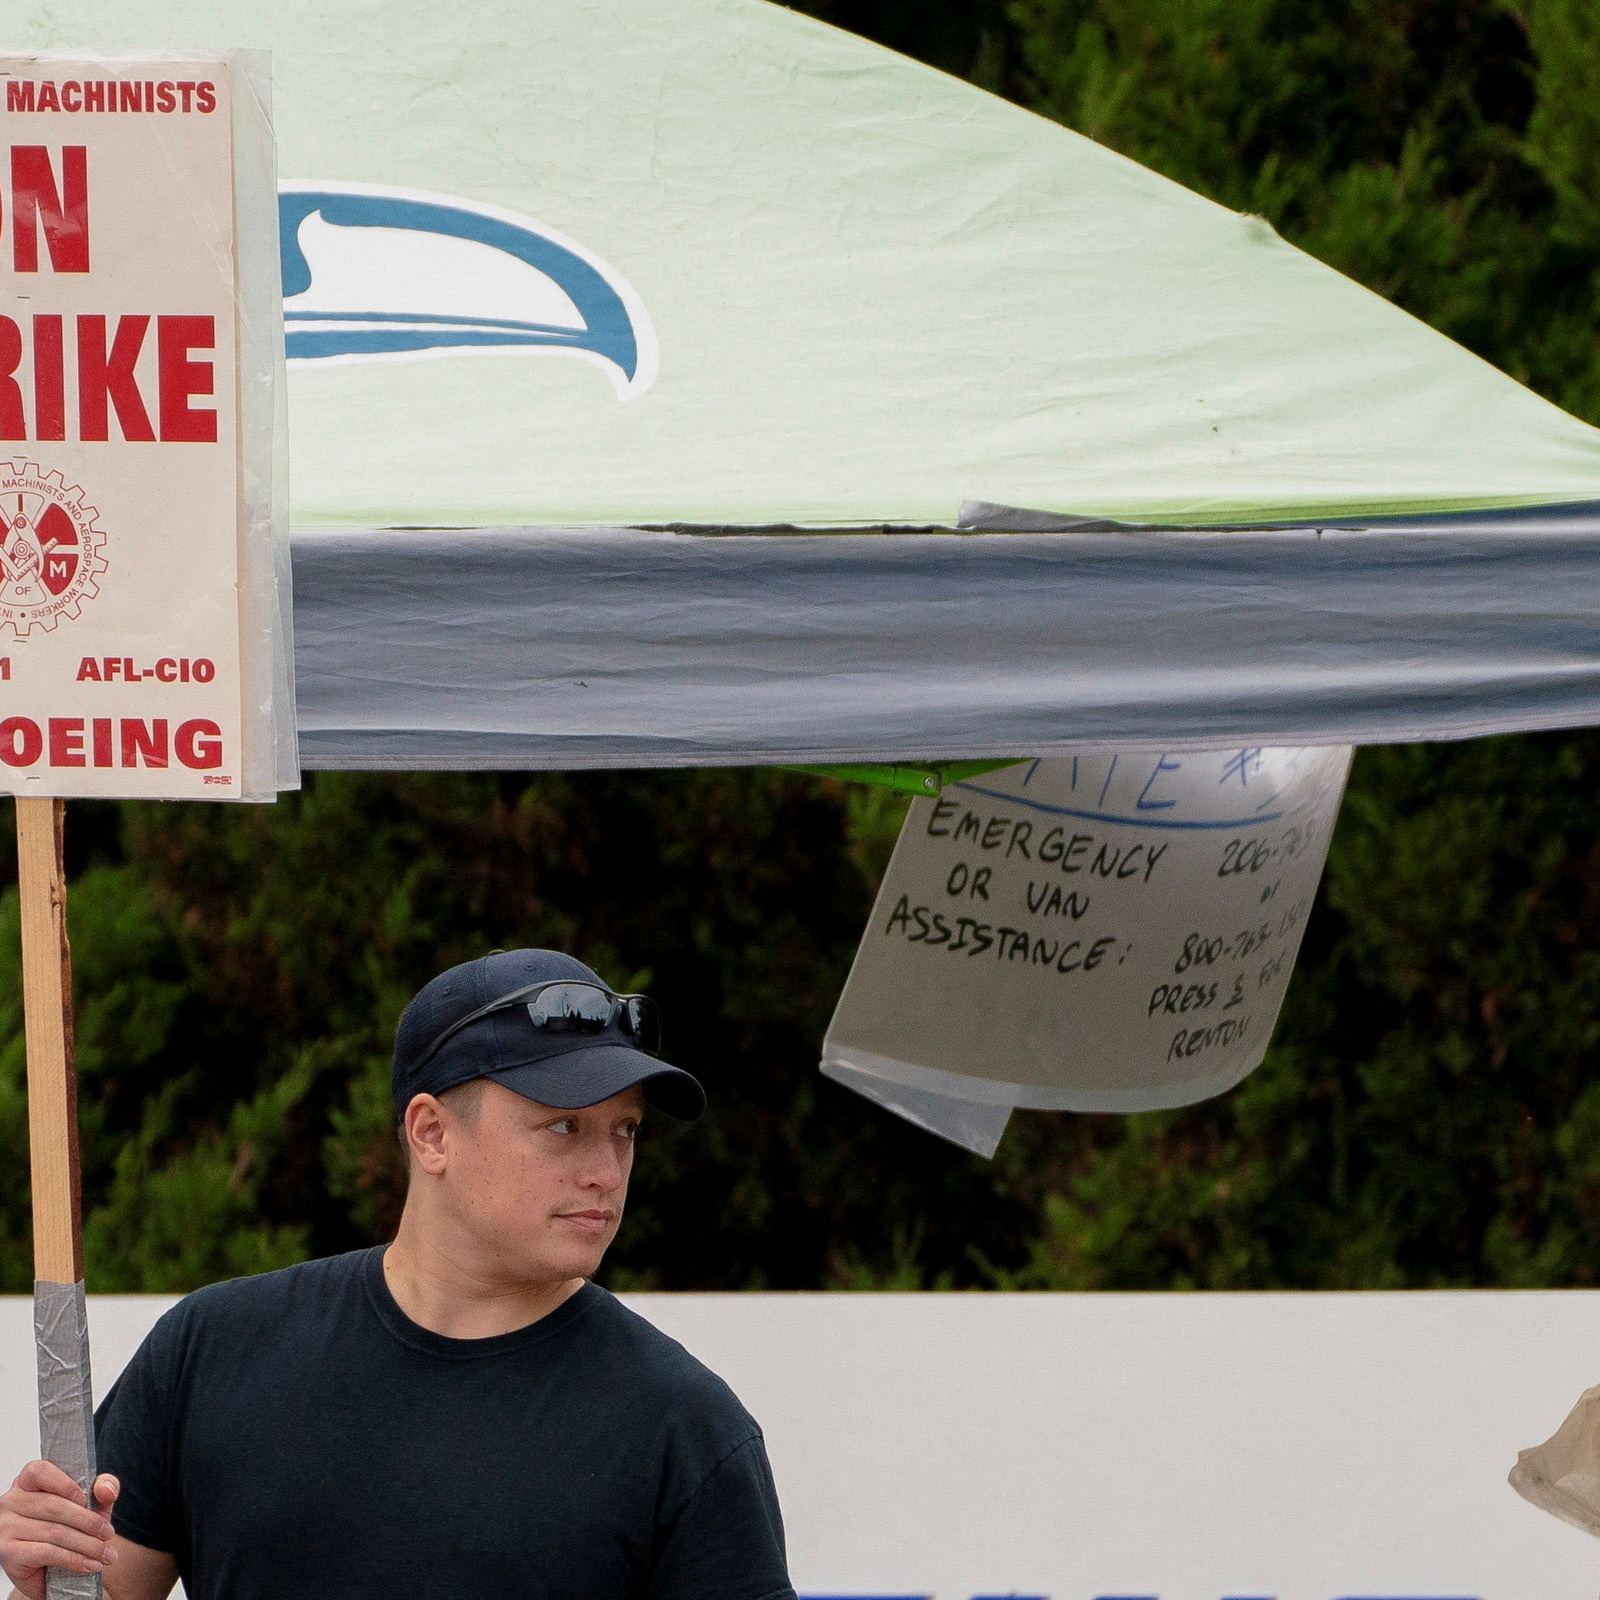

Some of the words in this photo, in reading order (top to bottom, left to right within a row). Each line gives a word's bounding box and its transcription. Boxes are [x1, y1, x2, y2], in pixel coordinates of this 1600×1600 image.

[7, 80, 217, 113] MACHINISTS
[14, 586, 32, 596] OF
[76, 657, 216, 683] AFL-CIO
[927, 798, 1169, 884] EMERGENCY
[947, 862, 992, 900] OR
[1027, 880, 1090, 920] VAN
[885, 894, 1133, 974] ASSISTANCE:
[1149, 982, 1219, 1018] PRESS
[1167, 1018, 1250, 1064] RENTON
